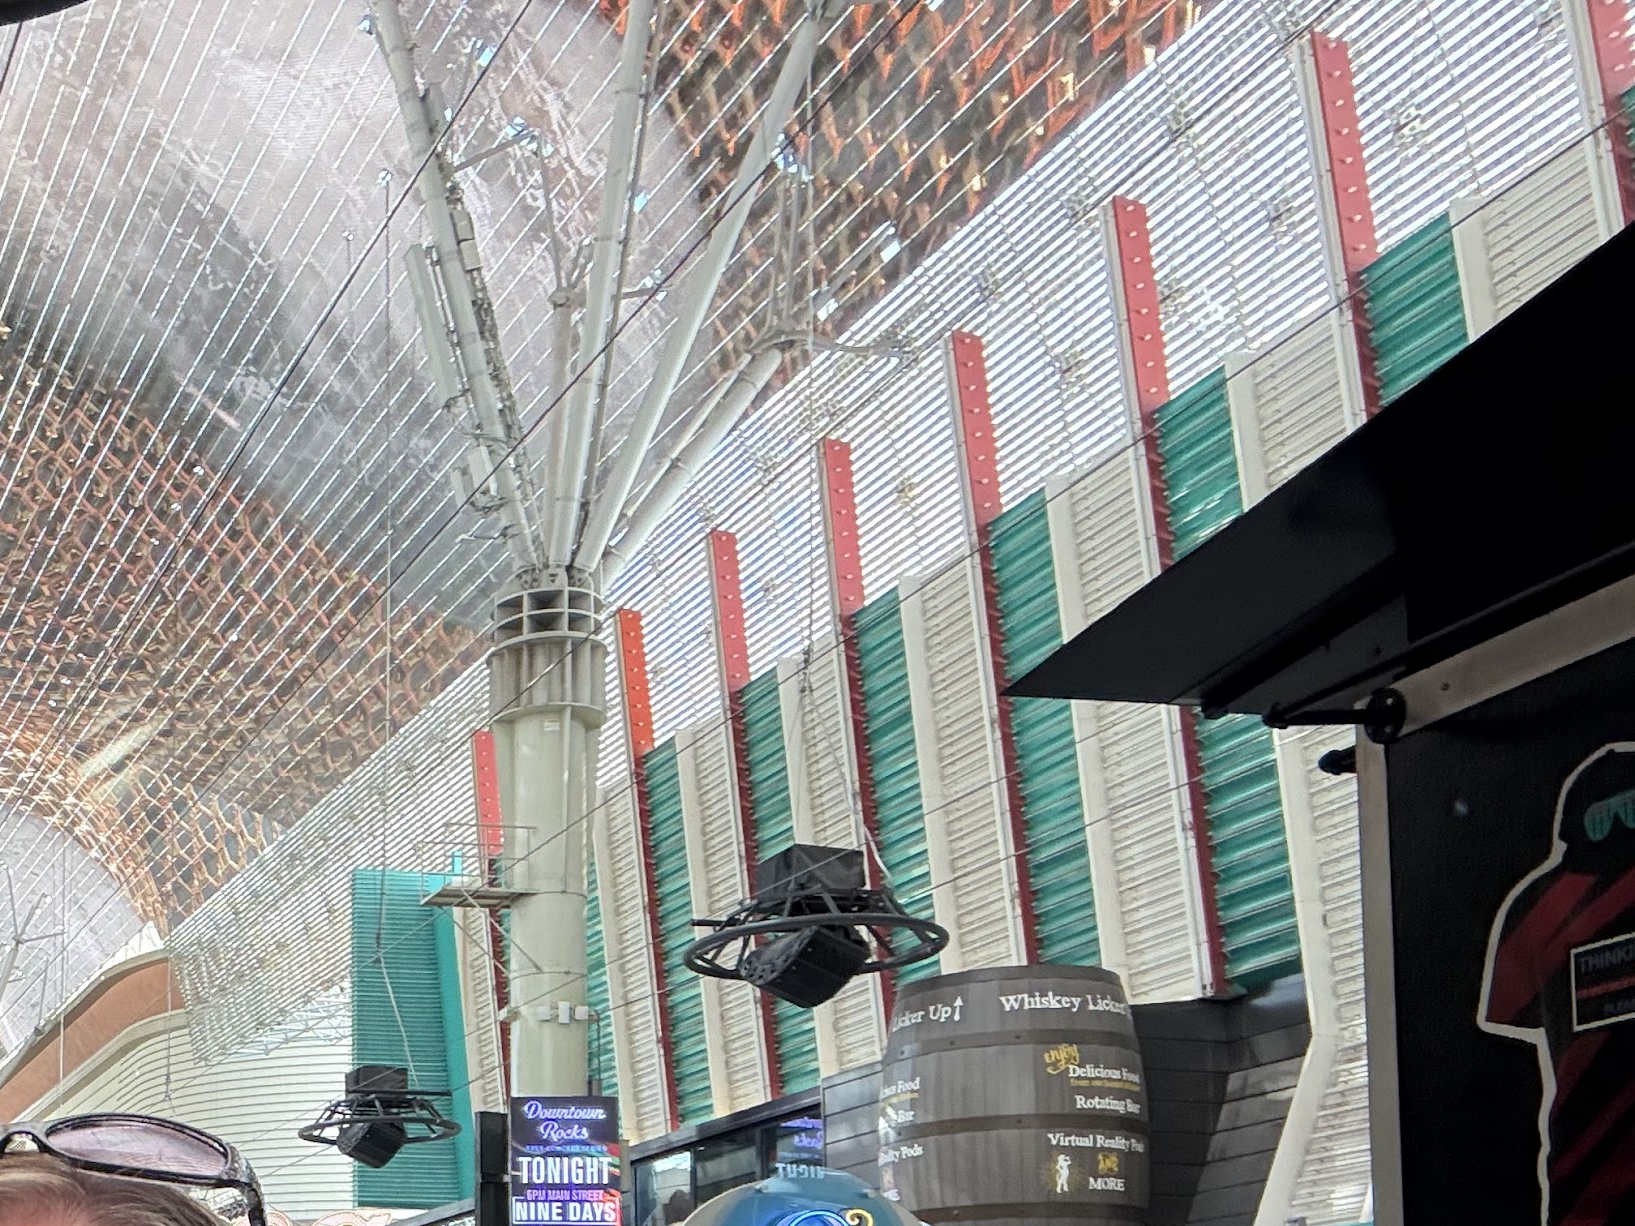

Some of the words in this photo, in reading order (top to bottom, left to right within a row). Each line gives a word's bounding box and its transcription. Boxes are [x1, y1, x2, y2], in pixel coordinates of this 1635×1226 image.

[999, 991, 1081, 1012] Whiskey
[929, 1004, 951, 1022] Up
[1043, 1043, 1080, 1075] enjoy
[1068, 1063, 1120, 1080] Delicious
[897, 1077, 920, 1093] Food
[523, 1100, 606, 1120] Downtown
[1075, 1094, 1125, 1114] Rotating
[539, 1121, 589, 1142] Rocks
[900, 1143, 923, 1160] Pods
[1047, 1133, 1094, 1148] Virtual
[1096, 1134, 1129, 1152] Reality
[518, 1156, 612, 1184] TONIGHT
[1089, 1177, 1125, 1192] MORE
[527, 1189, 546, 1200] 6PM
[548, 1190, 570, 1201] MAIN
[572, 1190, 604, 1201] STREET
[515, 1201, 563, 1221] NINE
[569, 1202, 615, 1222] DAYS
